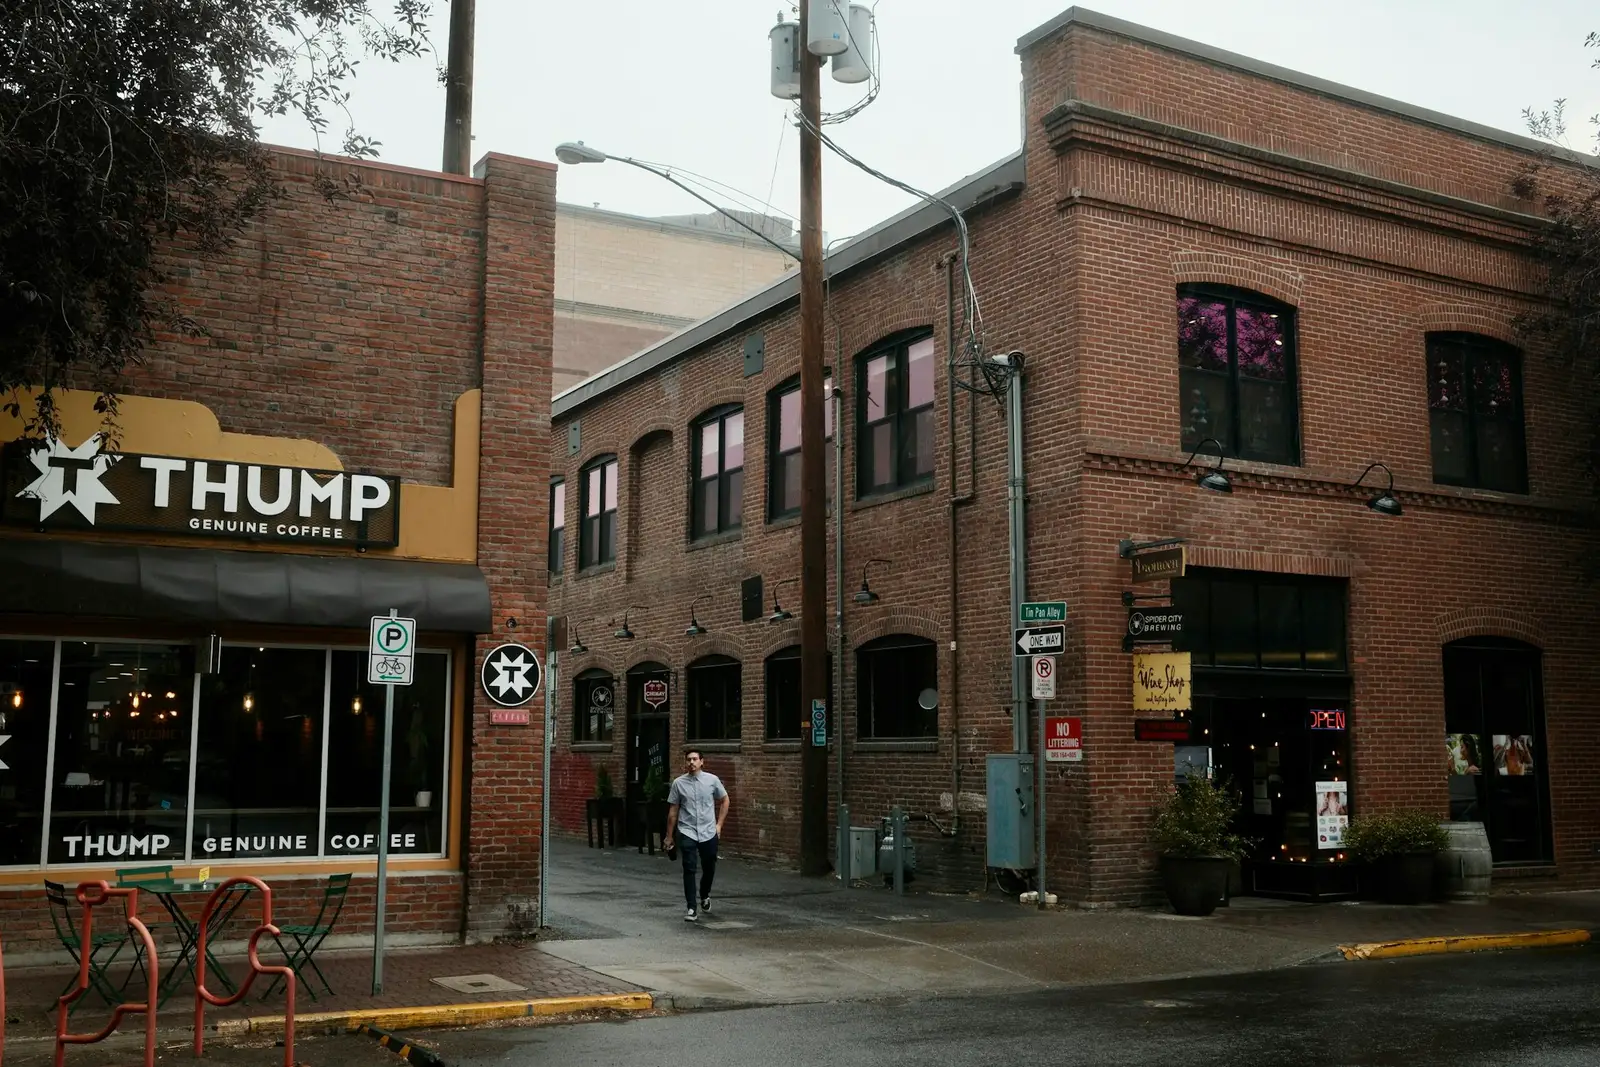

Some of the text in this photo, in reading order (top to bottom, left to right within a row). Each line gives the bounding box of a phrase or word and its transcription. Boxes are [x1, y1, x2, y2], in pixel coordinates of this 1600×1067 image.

[140, 456, 391, 522] THUMP
[189, 518, 343, 539] GENUINE COFFEE
[1025, 606, 1061, 620] Tin Pan Alley
[1145, 614, 1183, 624] SPIDER CITY
[1144, 624, 1182, 632] BREWING
[1030, 634, 1060, 647] ONE WAY
[1138, 664, 1185, 695] Wine Shop
[1310, 711, 1345, 728] OPEN
[1056, 722, 1070, 737] NO
[1048, 738, 1079, 748] LITTERING
[63, 833, 416, 857] THUMP GENUINE COFEE
